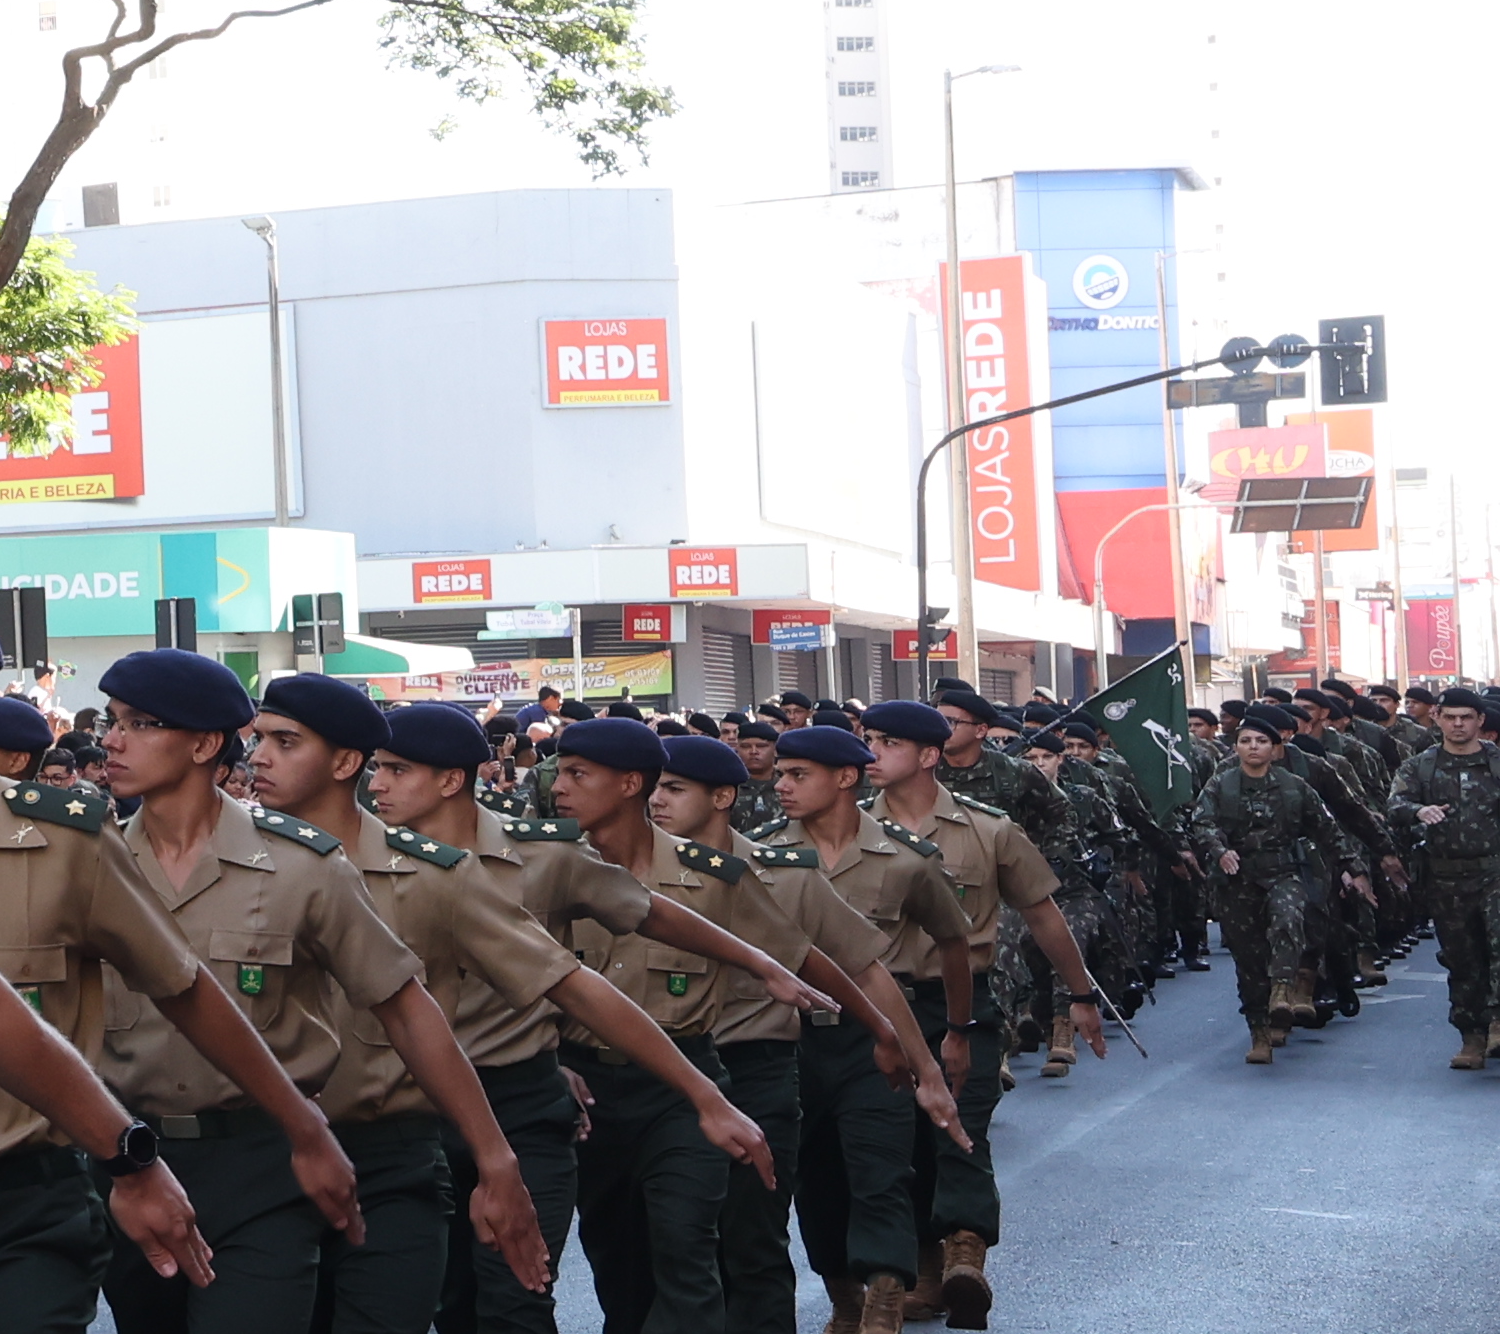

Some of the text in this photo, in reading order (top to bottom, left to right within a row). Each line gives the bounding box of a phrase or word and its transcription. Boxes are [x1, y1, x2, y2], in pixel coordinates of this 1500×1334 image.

[584, 322, 628, 337] LOJAS
[557, 343, 659, 381] REDE
[563, 392, 656, 403] PERFUMARIA E BELEZA
[30, 485, 40, 498] E
[44, 481, 107, 498] BELEZA
[690, 552, 715, 562] LOJAS
[437, 563, 465, 573] LOJAS
[676, 564, 731, 585] REDE
[420, 573, 483, 593] REDE
[633, 618, 661, 632] REDE
[404, 675, 440, 687] REDE
[455, 671, 521, 685] QUINZENA
[463, 677, 531, 695] CLIENTE
